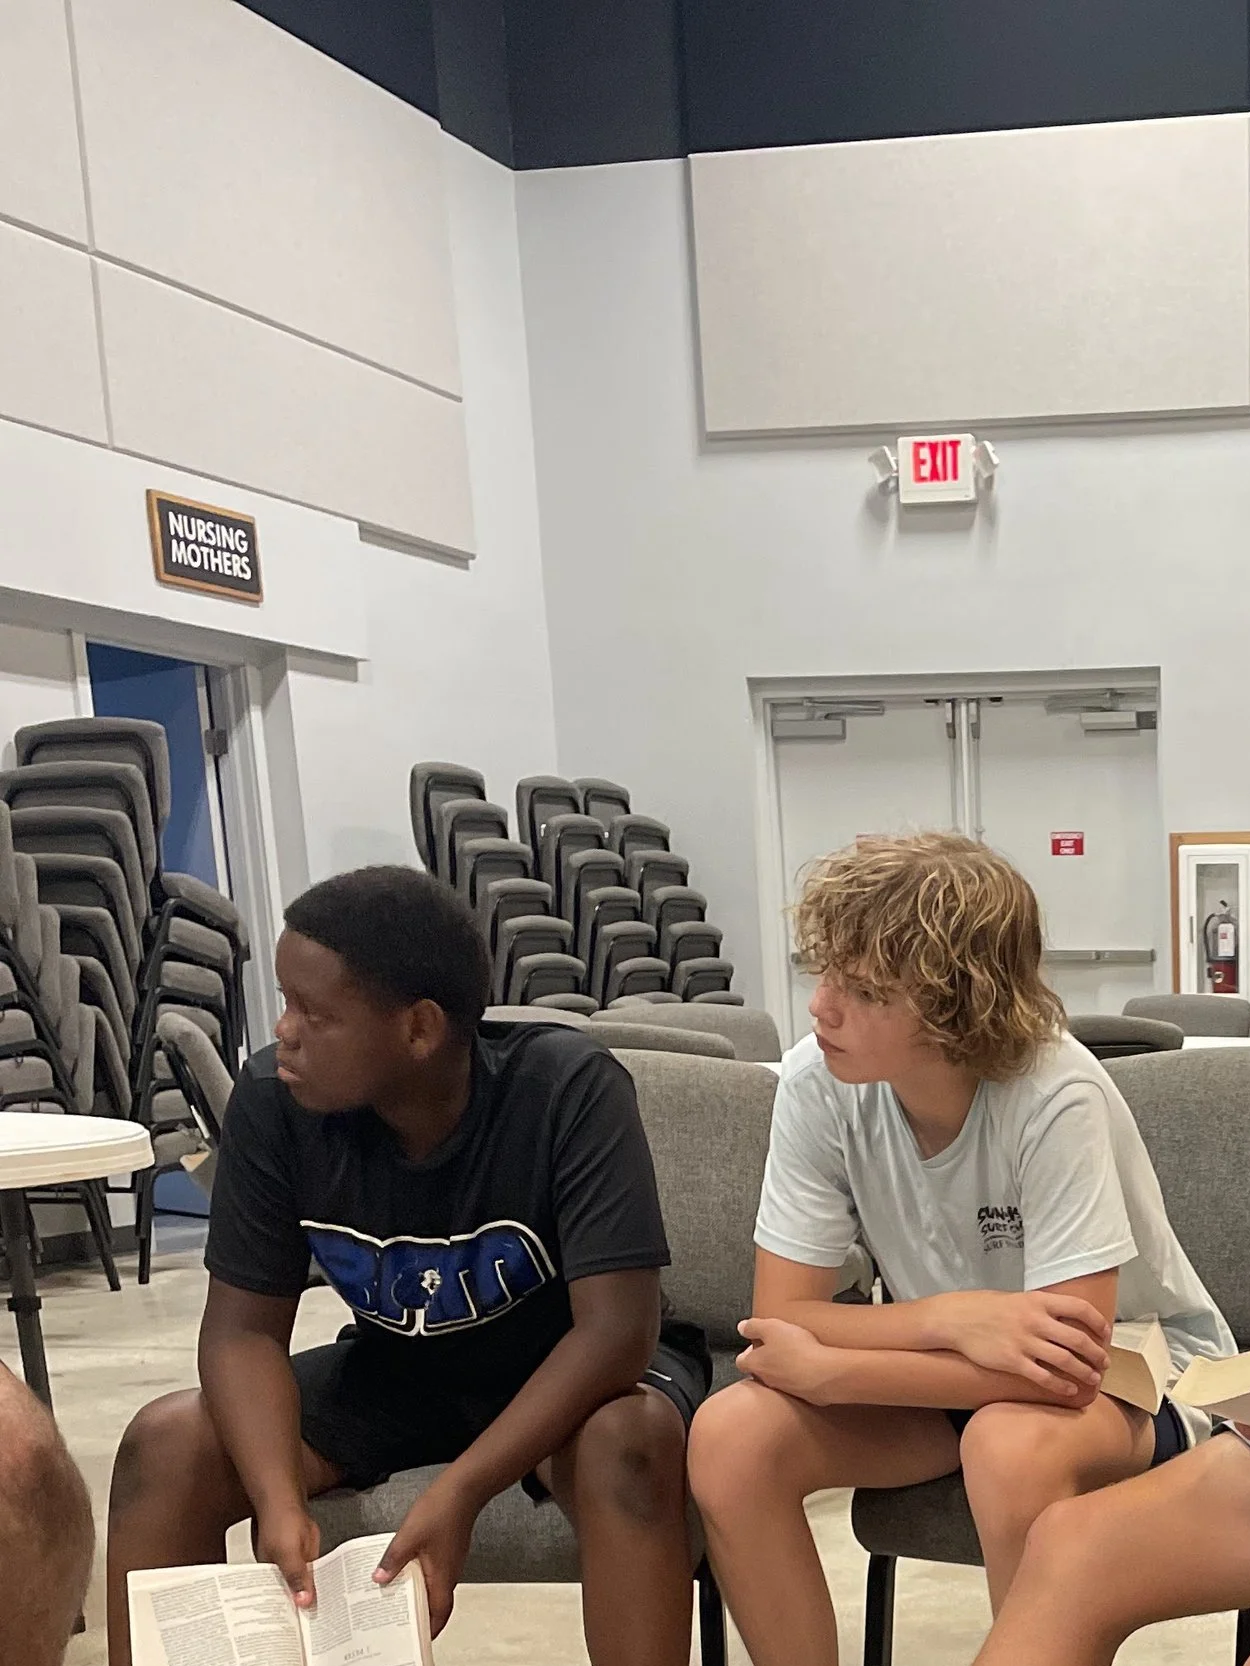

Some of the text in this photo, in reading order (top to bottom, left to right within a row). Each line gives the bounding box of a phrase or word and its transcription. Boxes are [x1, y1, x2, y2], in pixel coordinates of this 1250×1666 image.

[912, 440, 961, 482] EXIT
[168, 511, 248, 553] NURSING
[171, 539, 252, 580] MOTHERS
